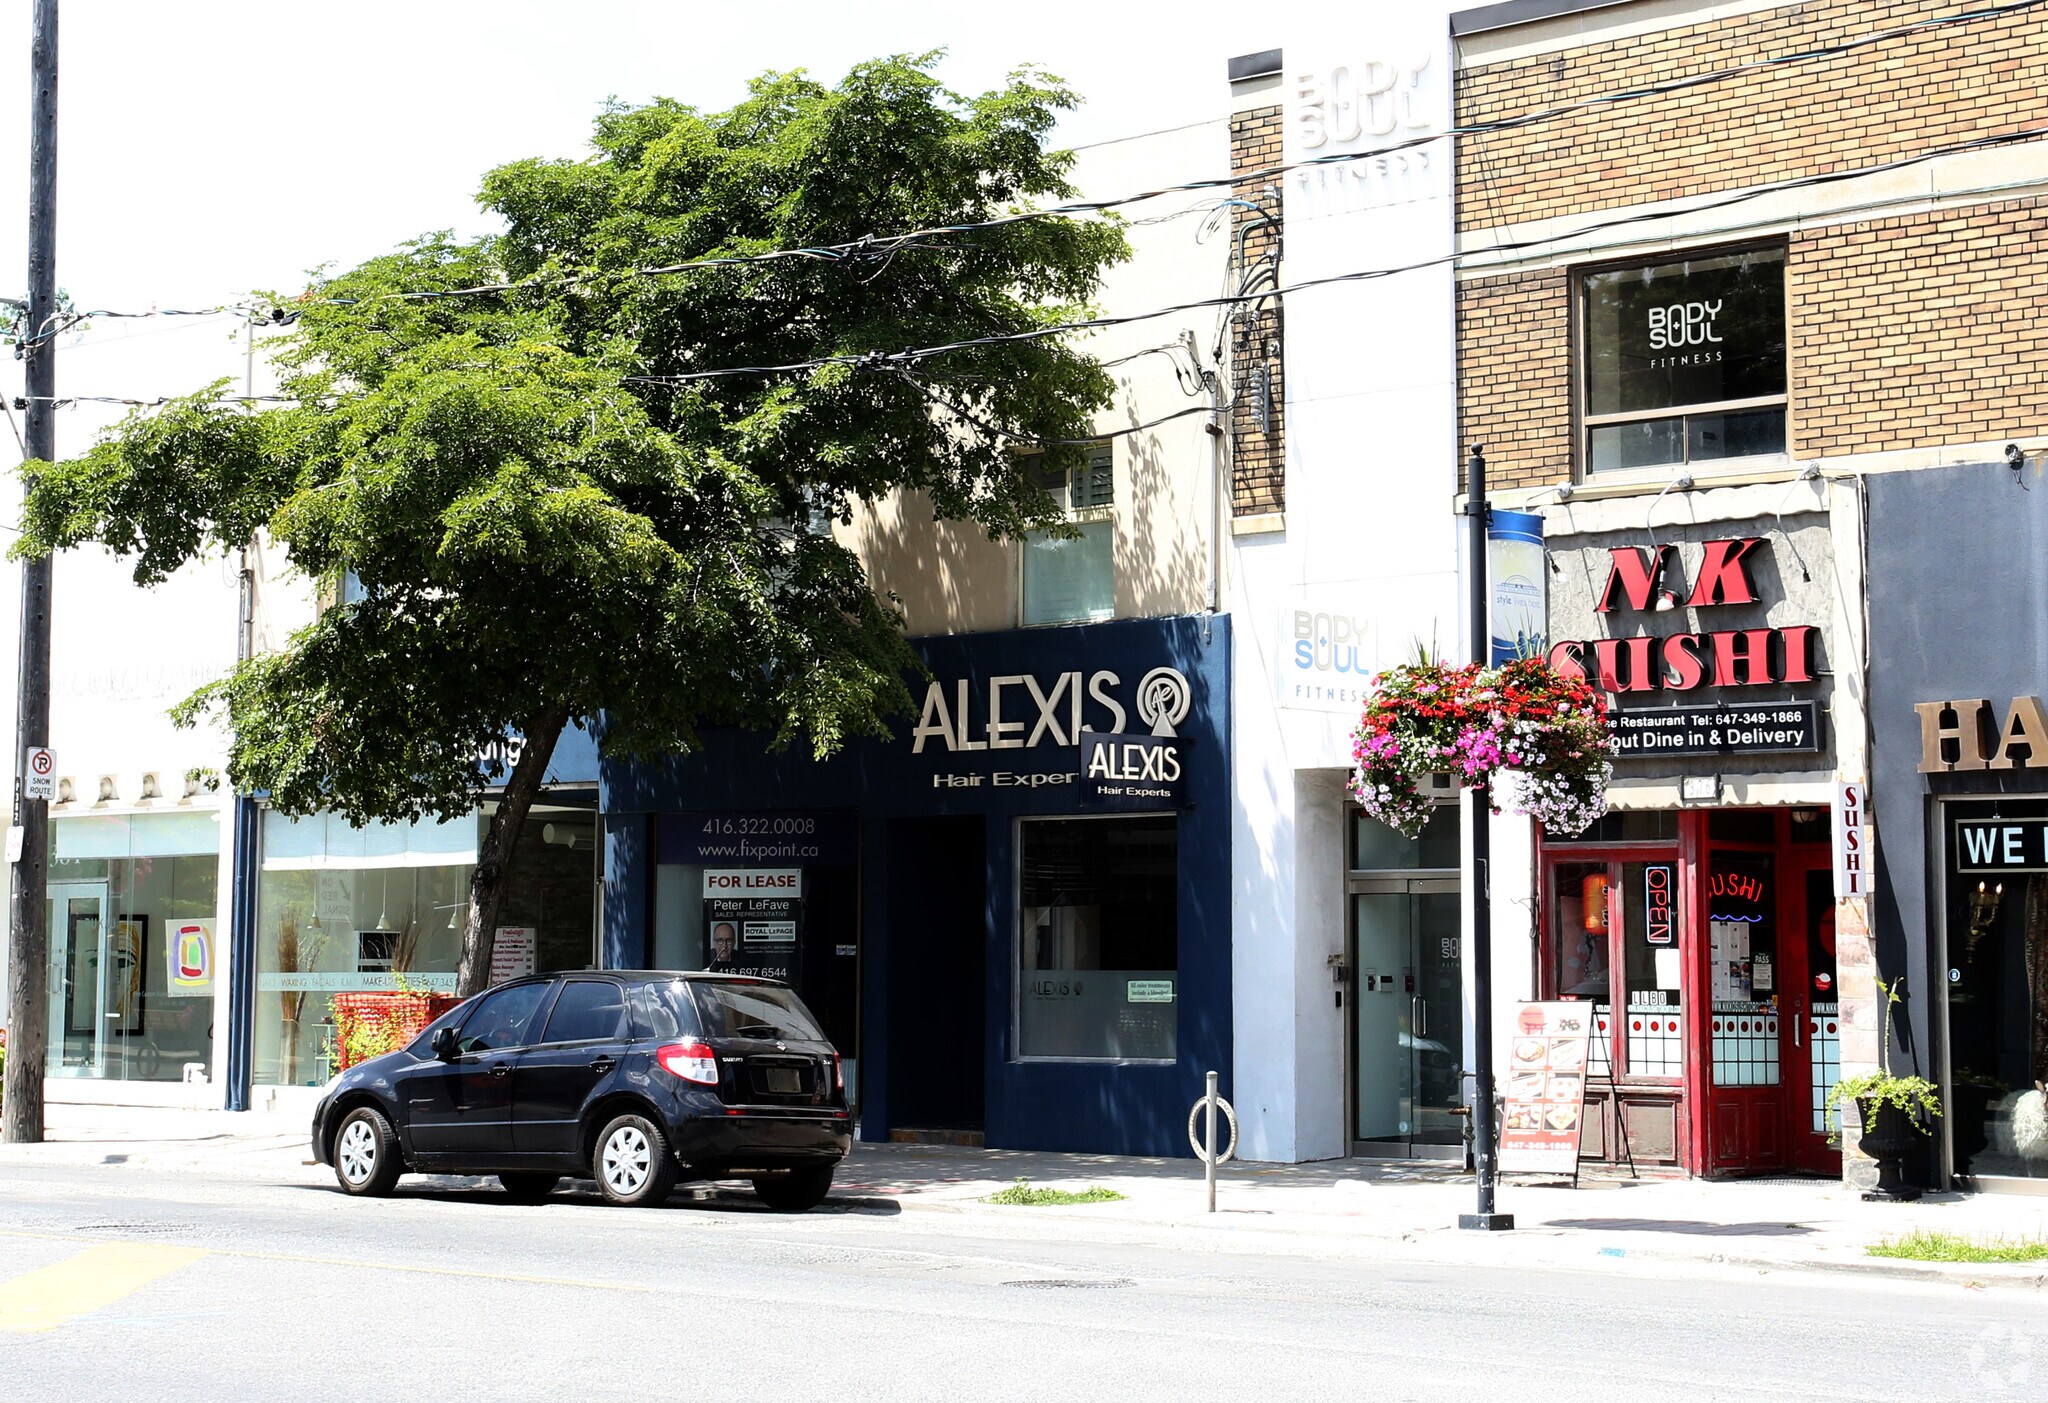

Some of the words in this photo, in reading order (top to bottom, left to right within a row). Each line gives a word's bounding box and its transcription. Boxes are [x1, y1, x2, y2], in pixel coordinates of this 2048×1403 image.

[1648, 299, 1723, 329] BODY
[1649, 322, 1723, 349] SOUL
[1651, 351, 1722, 369] FITNESS
[1295, 610, 1369, 645] BODY
[1295, 640, 1369, 675] SOUL
[1551, 626, 1813, 692] SUSHI
[1296, 685, 1368, 702] FITNESS
[912, 670, 1126, 753] ALEXIS
[1620, 714, 1685, 727] Restaurant
[1691, 714, 1712, 725] Tel:
[1715, 711, 1802, 725] 647-349-1866
[1643, 731, 1684, 747] Dine
[1689, 731, 1704, 746] in
[1709, 730, 1721, 745] &
[1728, 728, 1804, 746] Delivery
[1914, 696, 2048, 773] HA
[1088, 742, 1181, 782] ALEXIS
[933, 773, 986, 787] Hair
[993, 771, 1079, 787] Exper
[30, 787, 51, 795] ROUTE
[1097, 786, 1122, 796] Hair
[1126, 787, 1170, 797] Experts
[702, 818, 815, 834] 416.322.0008
[1844, 787, 1860, 893] SUSHI
[1964, 827, 2025, 864] WE
[698, 839, 819, 861] www.fixpoint.ca
[708, 876, 742, 888] FOR
[746, 875, 796, 888] LEASE
[1709, 873, 1763, 902] USHI
[714, 900, 743, 910] Peter
[750, 900, 789, 910] LeFave
[1649, 870, 1669, 940] OPEN
[1441, 937, 1461, 948] BO
[1441, 948, 1461, 959] SO
[1755, 955, 1769, 963] PASS
[740, 968, 759, 976] 697
[761, 968, 787, 977] 6544
[281, 977, 307, 986] WAXING
[1031, 981, 1070, 995] ALEXIS
[1633, 992, 1666, 1004] LLBO
